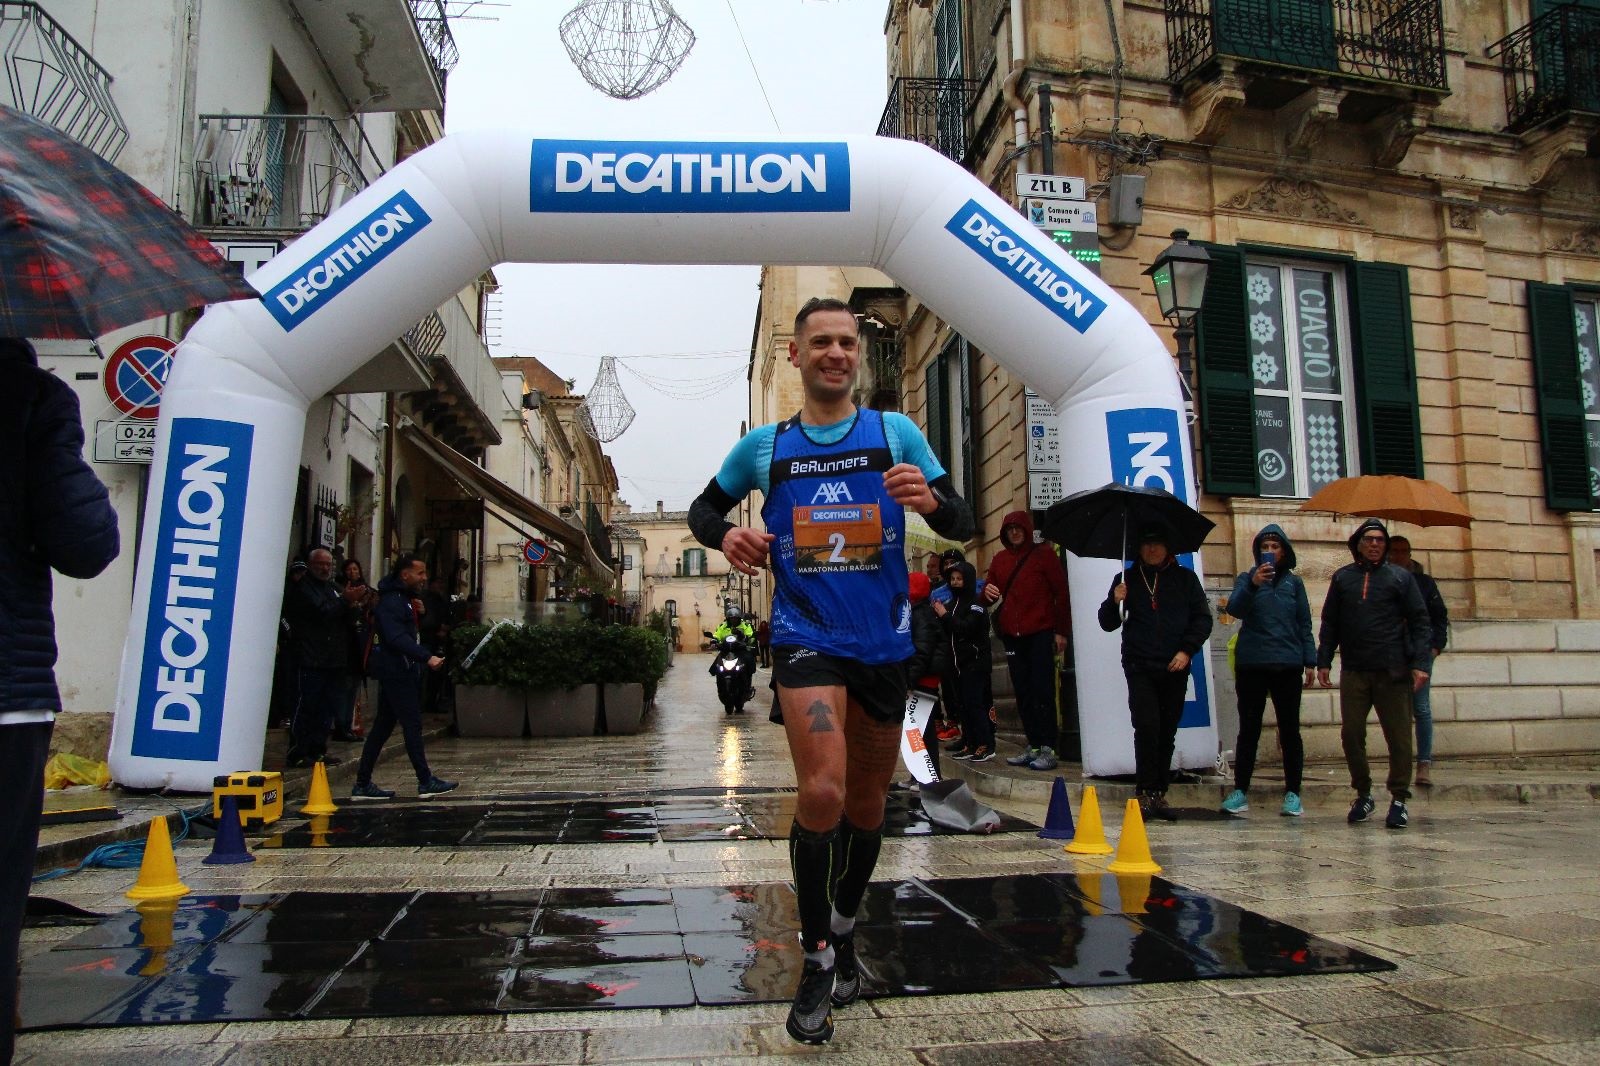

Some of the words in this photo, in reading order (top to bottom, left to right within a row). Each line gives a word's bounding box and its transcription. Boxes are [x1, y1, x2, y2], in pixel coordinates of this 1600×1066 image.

[554, 152, 827, 194] DECATHLON
[1030, 179, 1056, 193] ZTL
[1062, 181, 1072, 194] B
[1047, 206, 1072, 215] Comune
[1073, 207, 1080, 215] di
[1048, 215, 1071, 224] Ragusa
[275, 203, 414, 316] DECATHLON
[962, 212, 1092, 319] DECATHLON
[1261, 418, 1283, 428] VINO
[124, 427, 156, 439] 0-24
[790, 456, 868, 475] BeRunners
[810, 481, 853, 504] AXA
[813, 510, 860, 520] DECATHLON
[828, 532, 846, 563] 2
[849, 564, 879, 572] RAGUSA
[151, 443, 231, 733] DECATHLON
